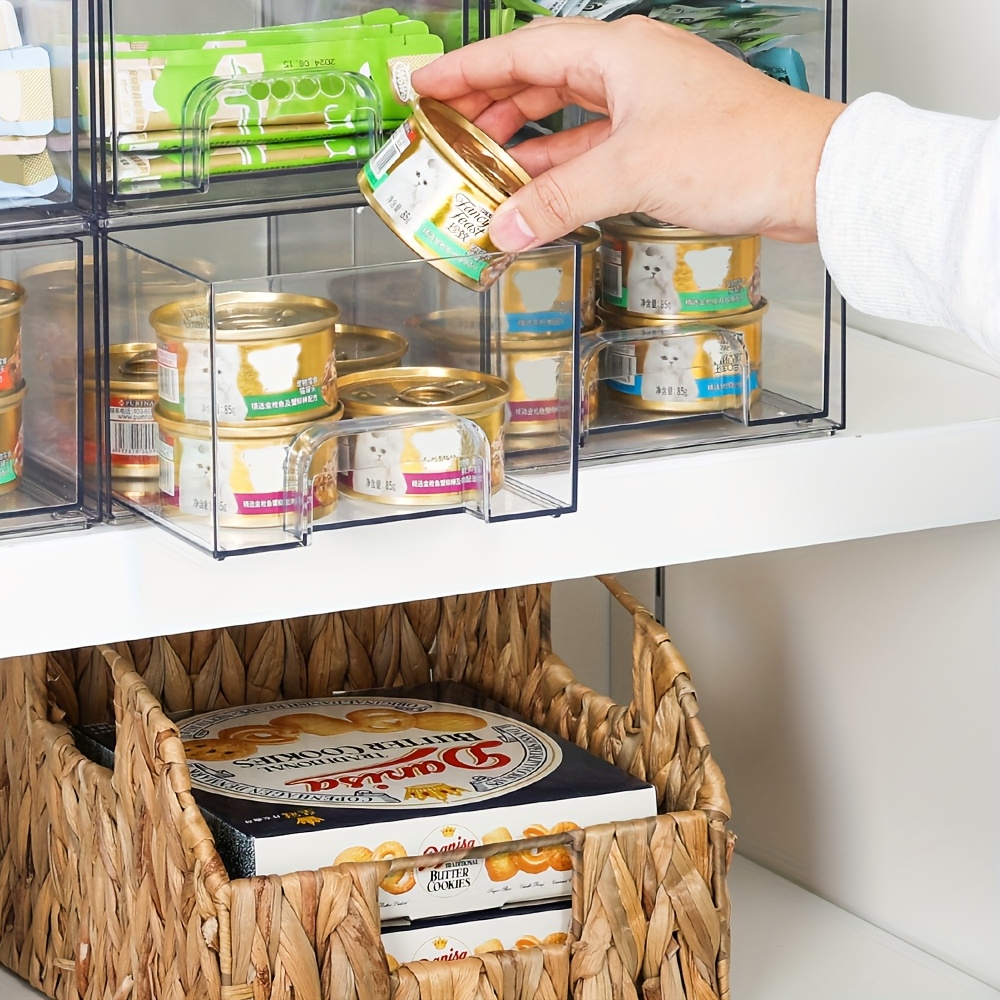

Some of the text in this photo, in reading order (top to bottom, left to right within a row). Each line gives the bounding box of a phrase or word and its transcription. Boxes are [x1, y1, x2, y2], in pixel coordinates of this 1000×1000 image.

[455, 192, 491, 228] Fancy
[452, 210, 486, 237] Feast
[233, 732, 483, 768] BUTTER COOKIES
[258, 753, 388, 773] TRADITIONAL
[286, 740, 512, 792] Danisa
[252, 787, 373, 803] COPENHAGEN
[445, 859, 479, 869] TRADITIONAL
[430, 867, 469, 882] BUTTER
[427, 878, 471, 893] COOKIES
[420, 947, 468, 962] anisa
